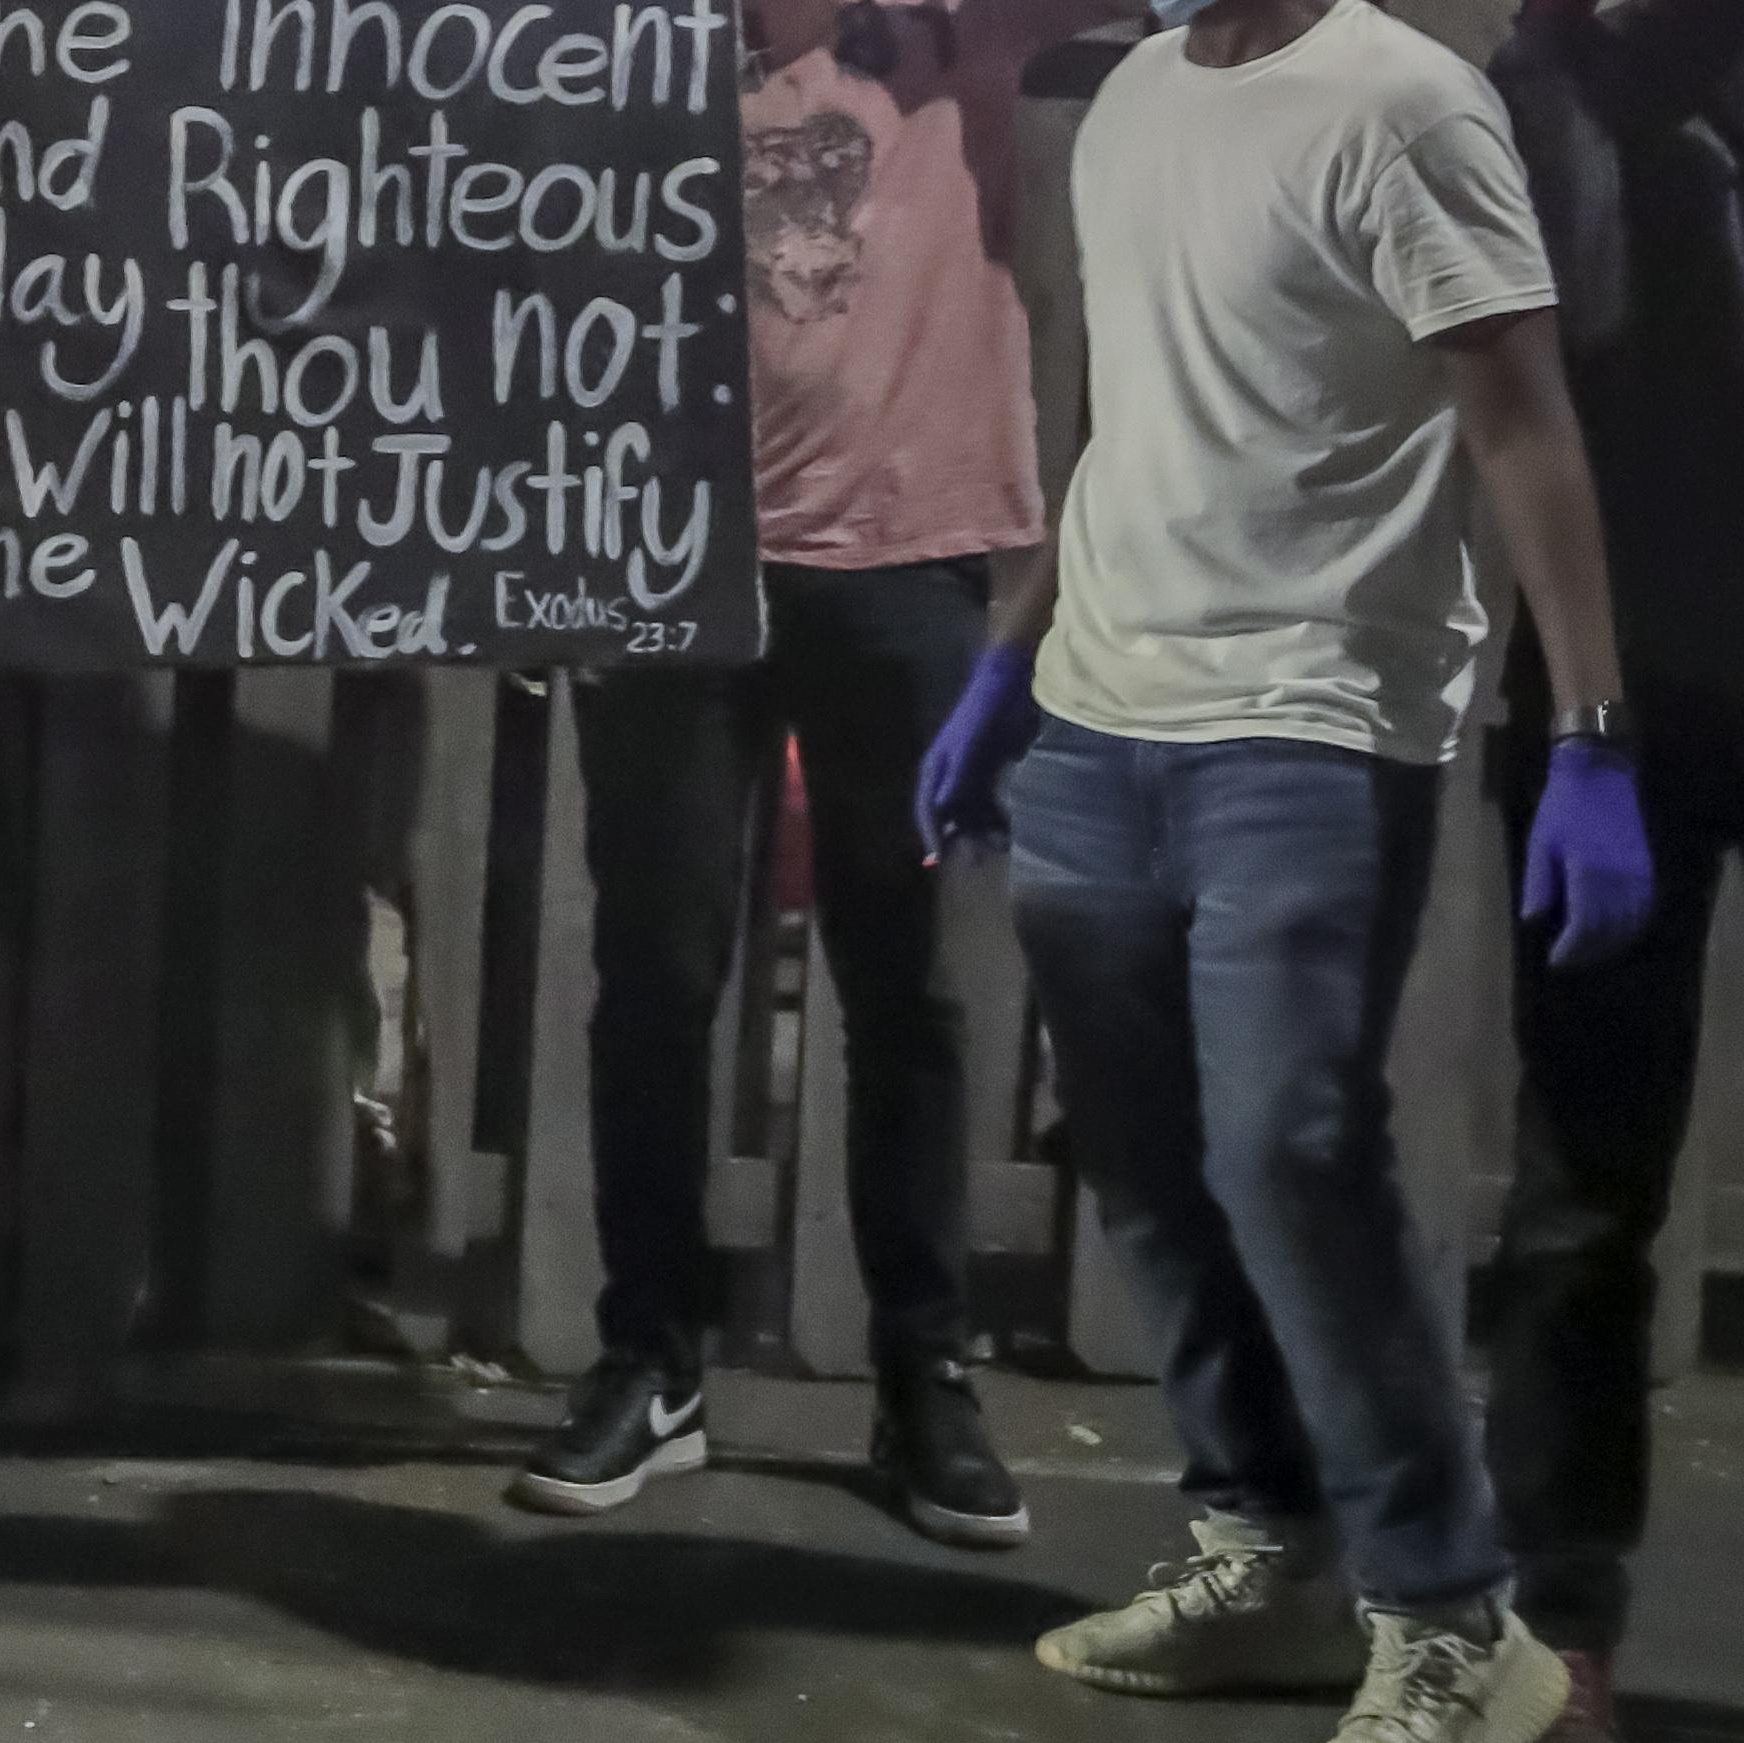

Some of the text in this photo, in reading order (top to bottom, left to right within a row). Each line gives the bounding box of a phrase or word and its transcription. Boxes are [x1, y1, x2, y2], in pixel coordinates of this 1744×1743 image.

[167, 105, 723, 335] Righteous
[166, 261, 446, 427] thou
[212, 421, 355, 528] not
[357, 420, 712, 609] Justify
[494, 569, 699, 655] Exodus 23:7
